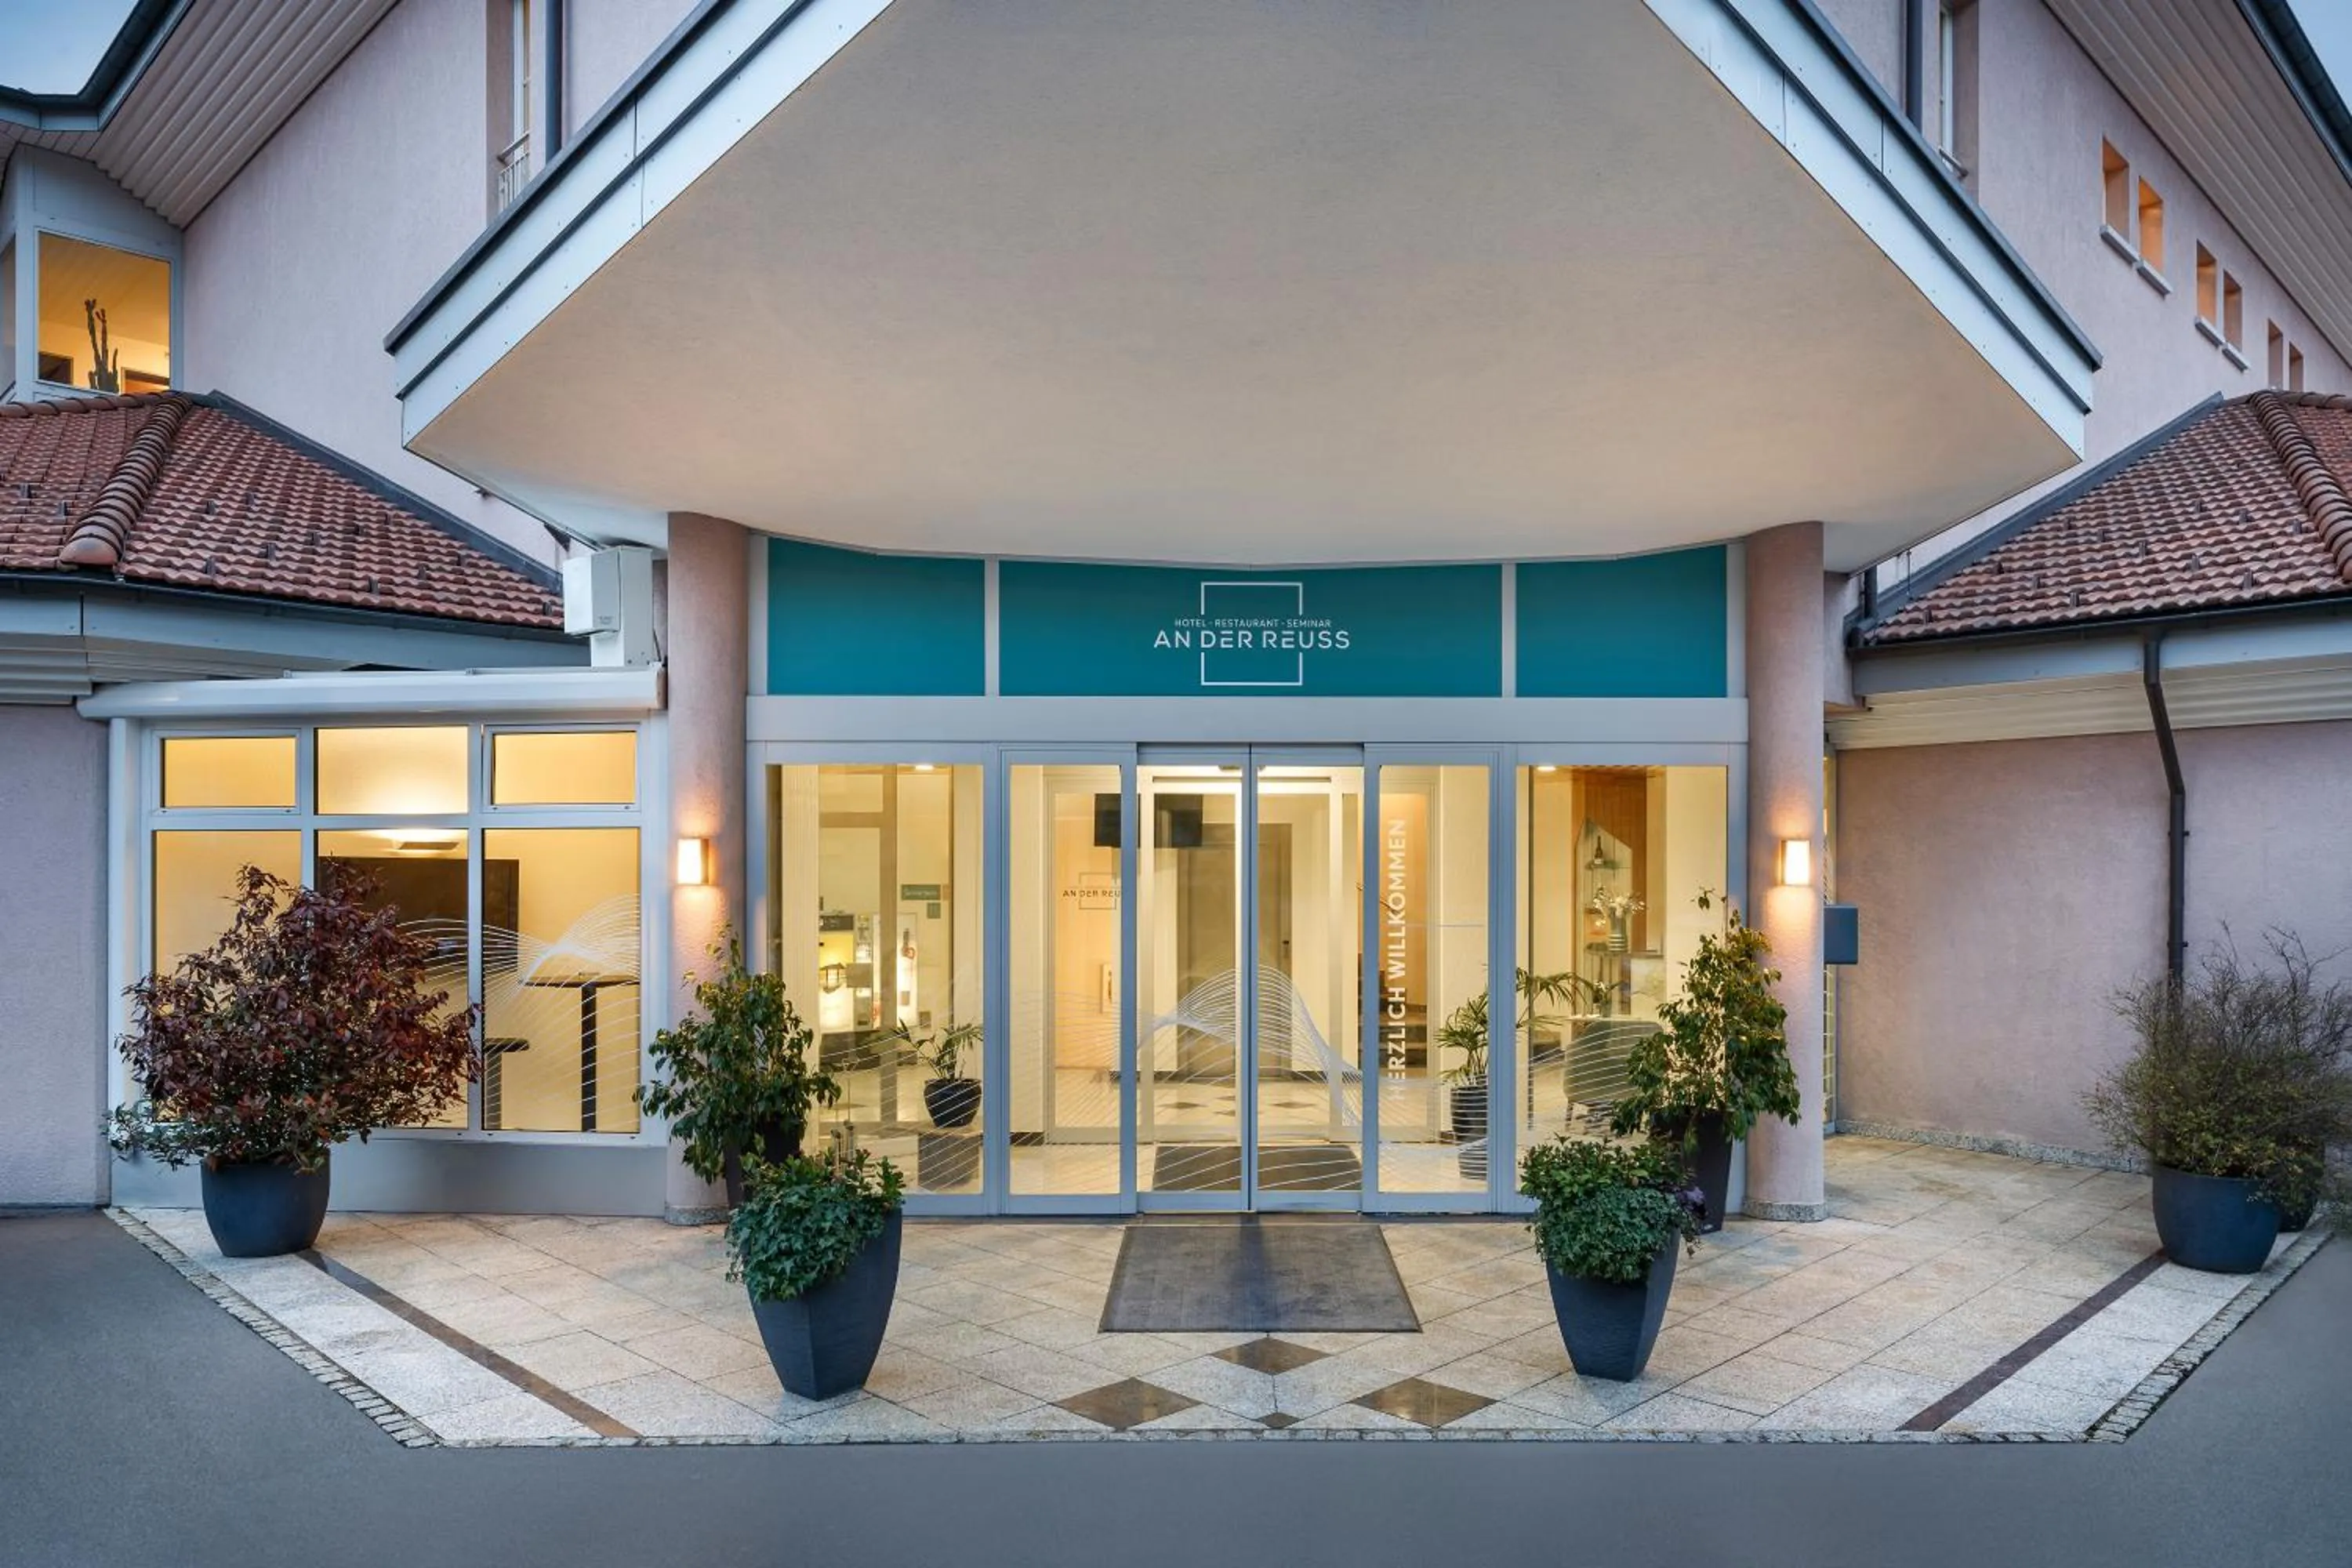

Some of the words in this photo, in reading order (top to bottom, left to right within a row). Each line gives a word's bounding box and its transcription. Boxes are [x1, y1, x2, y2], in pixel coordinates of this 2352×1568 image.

[1175, 619, 1207, 627] HOTEL
[1215, 619, 1279, 627] RESTAURANT
[1287, 619, 1331, 627] SEMINAR
[1153, 630, 1190, 648] AN
[1200, 630, 1252, 648] DER
[1262, 630, 1350, 649] REUSS
[1388, 818, 1406, 979] WILLKOMMEN
